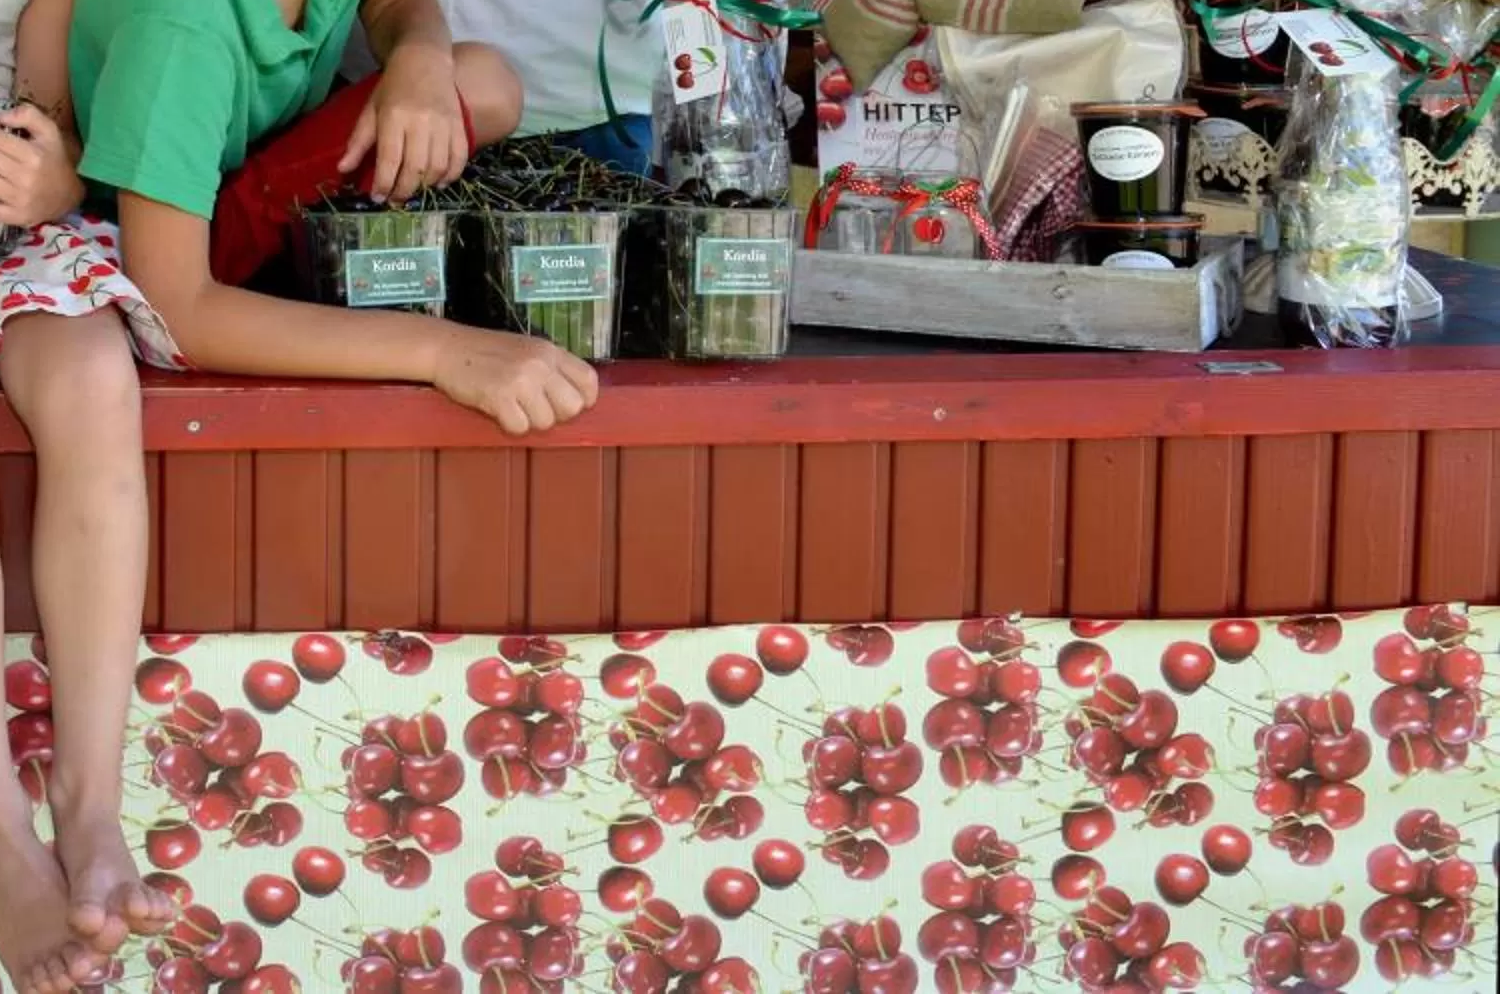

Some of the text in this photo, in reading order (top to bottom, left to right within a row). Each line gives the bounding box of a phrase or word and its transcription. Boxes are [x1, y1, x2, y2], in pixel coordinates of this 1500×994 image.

[540, 255, 585, 269] Kordia
[723, 248, 767, 262] Kordia
[372, 258, 417, 272] Kordia
